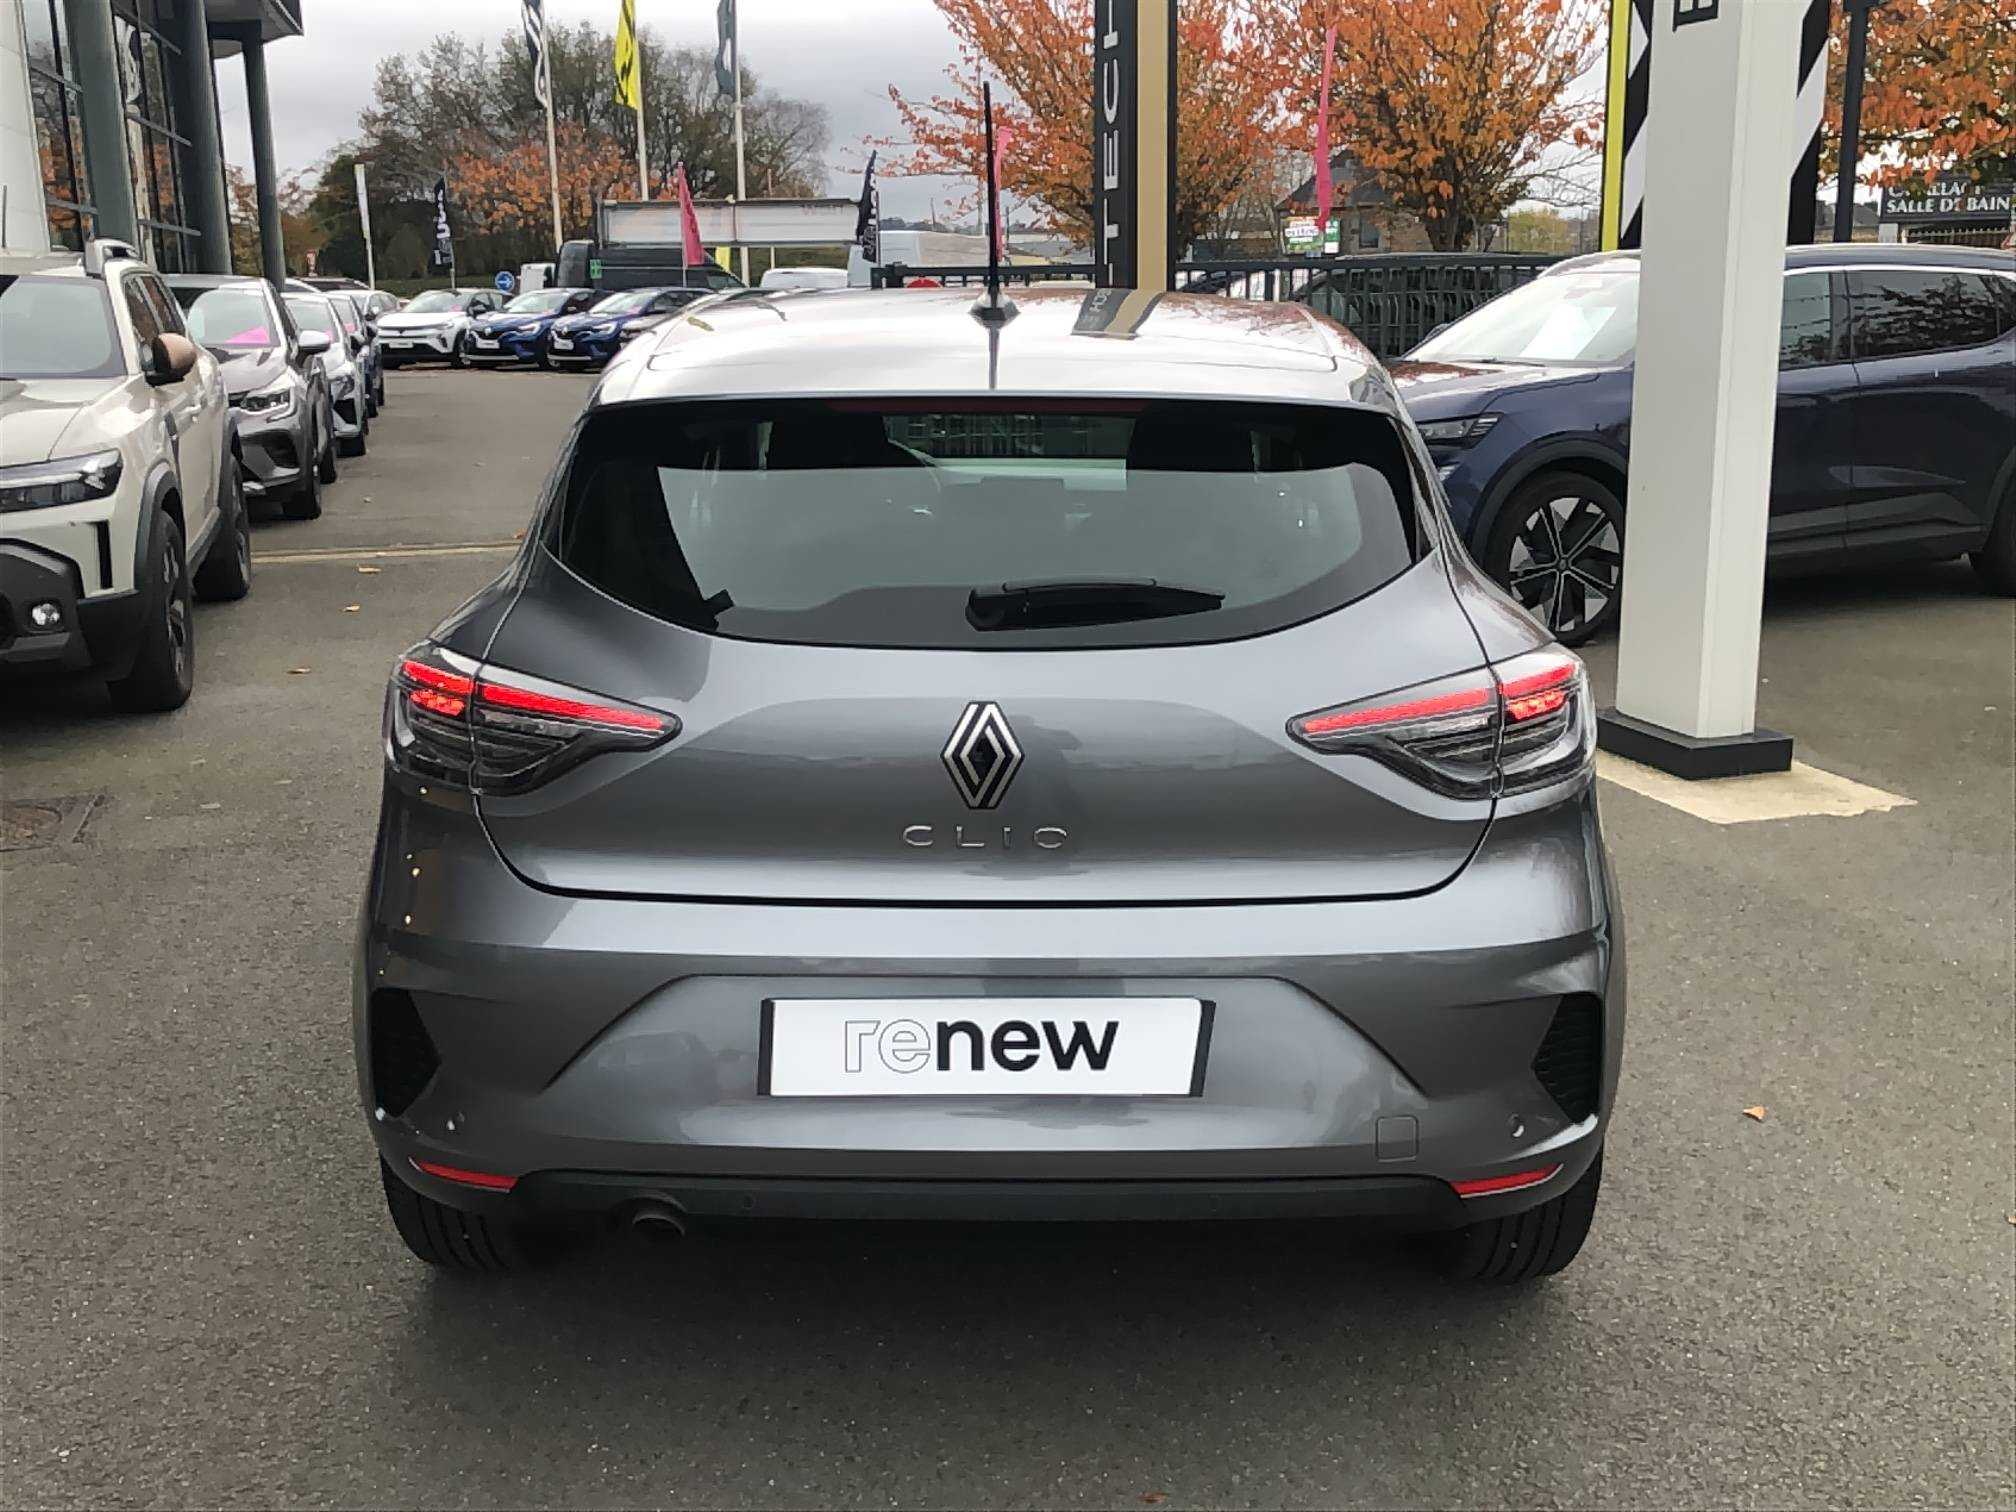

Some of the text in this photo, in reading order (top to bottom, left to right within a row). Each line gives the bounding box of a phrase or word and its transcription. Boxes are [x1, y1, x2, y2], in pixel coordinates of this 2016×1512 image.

[1887, 199, 1934, 213] SALLE
[1967, 196, 2011, 212] BAIN
[902, 824, 1068, 849] CLIO
[844, 1018, 1120, 1074] renew
